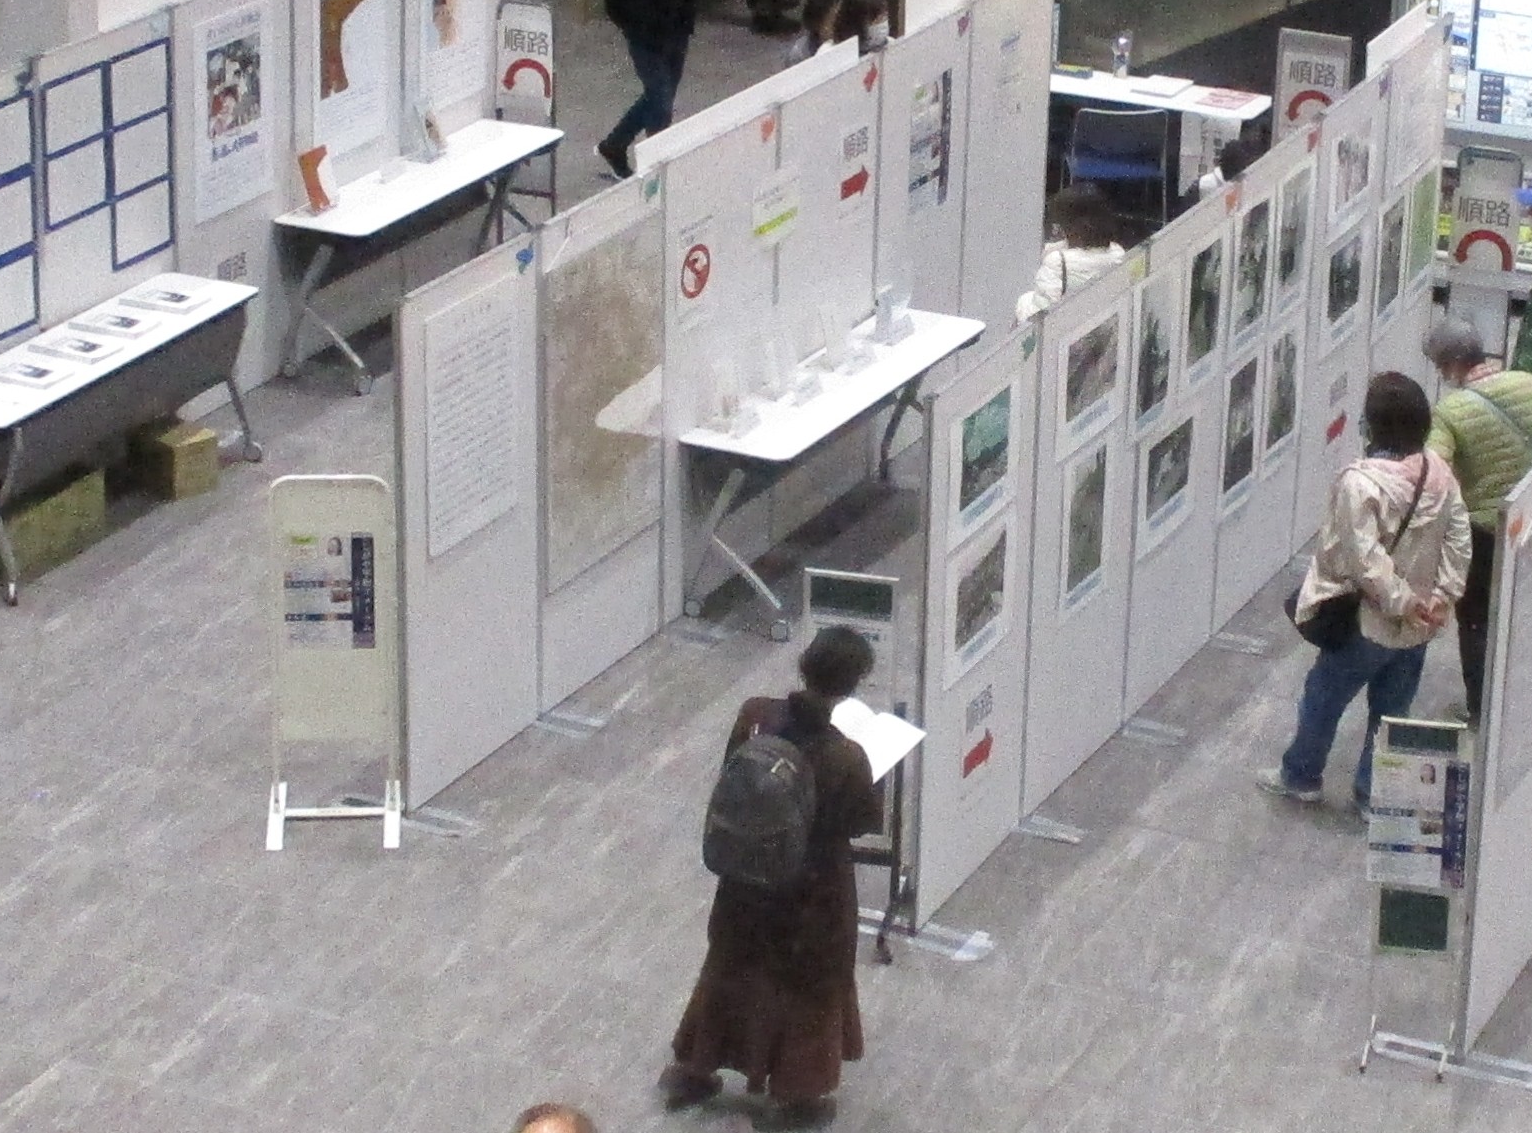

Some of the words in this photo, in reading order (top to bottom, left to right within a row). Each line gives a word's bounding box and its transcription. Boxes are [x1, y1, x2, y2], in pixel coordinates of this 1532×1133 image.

[504, 25, 549, 56] 順路
[1289, 60, 1337, 89] 順路
[1458, 195, 1511, 227] 順路
